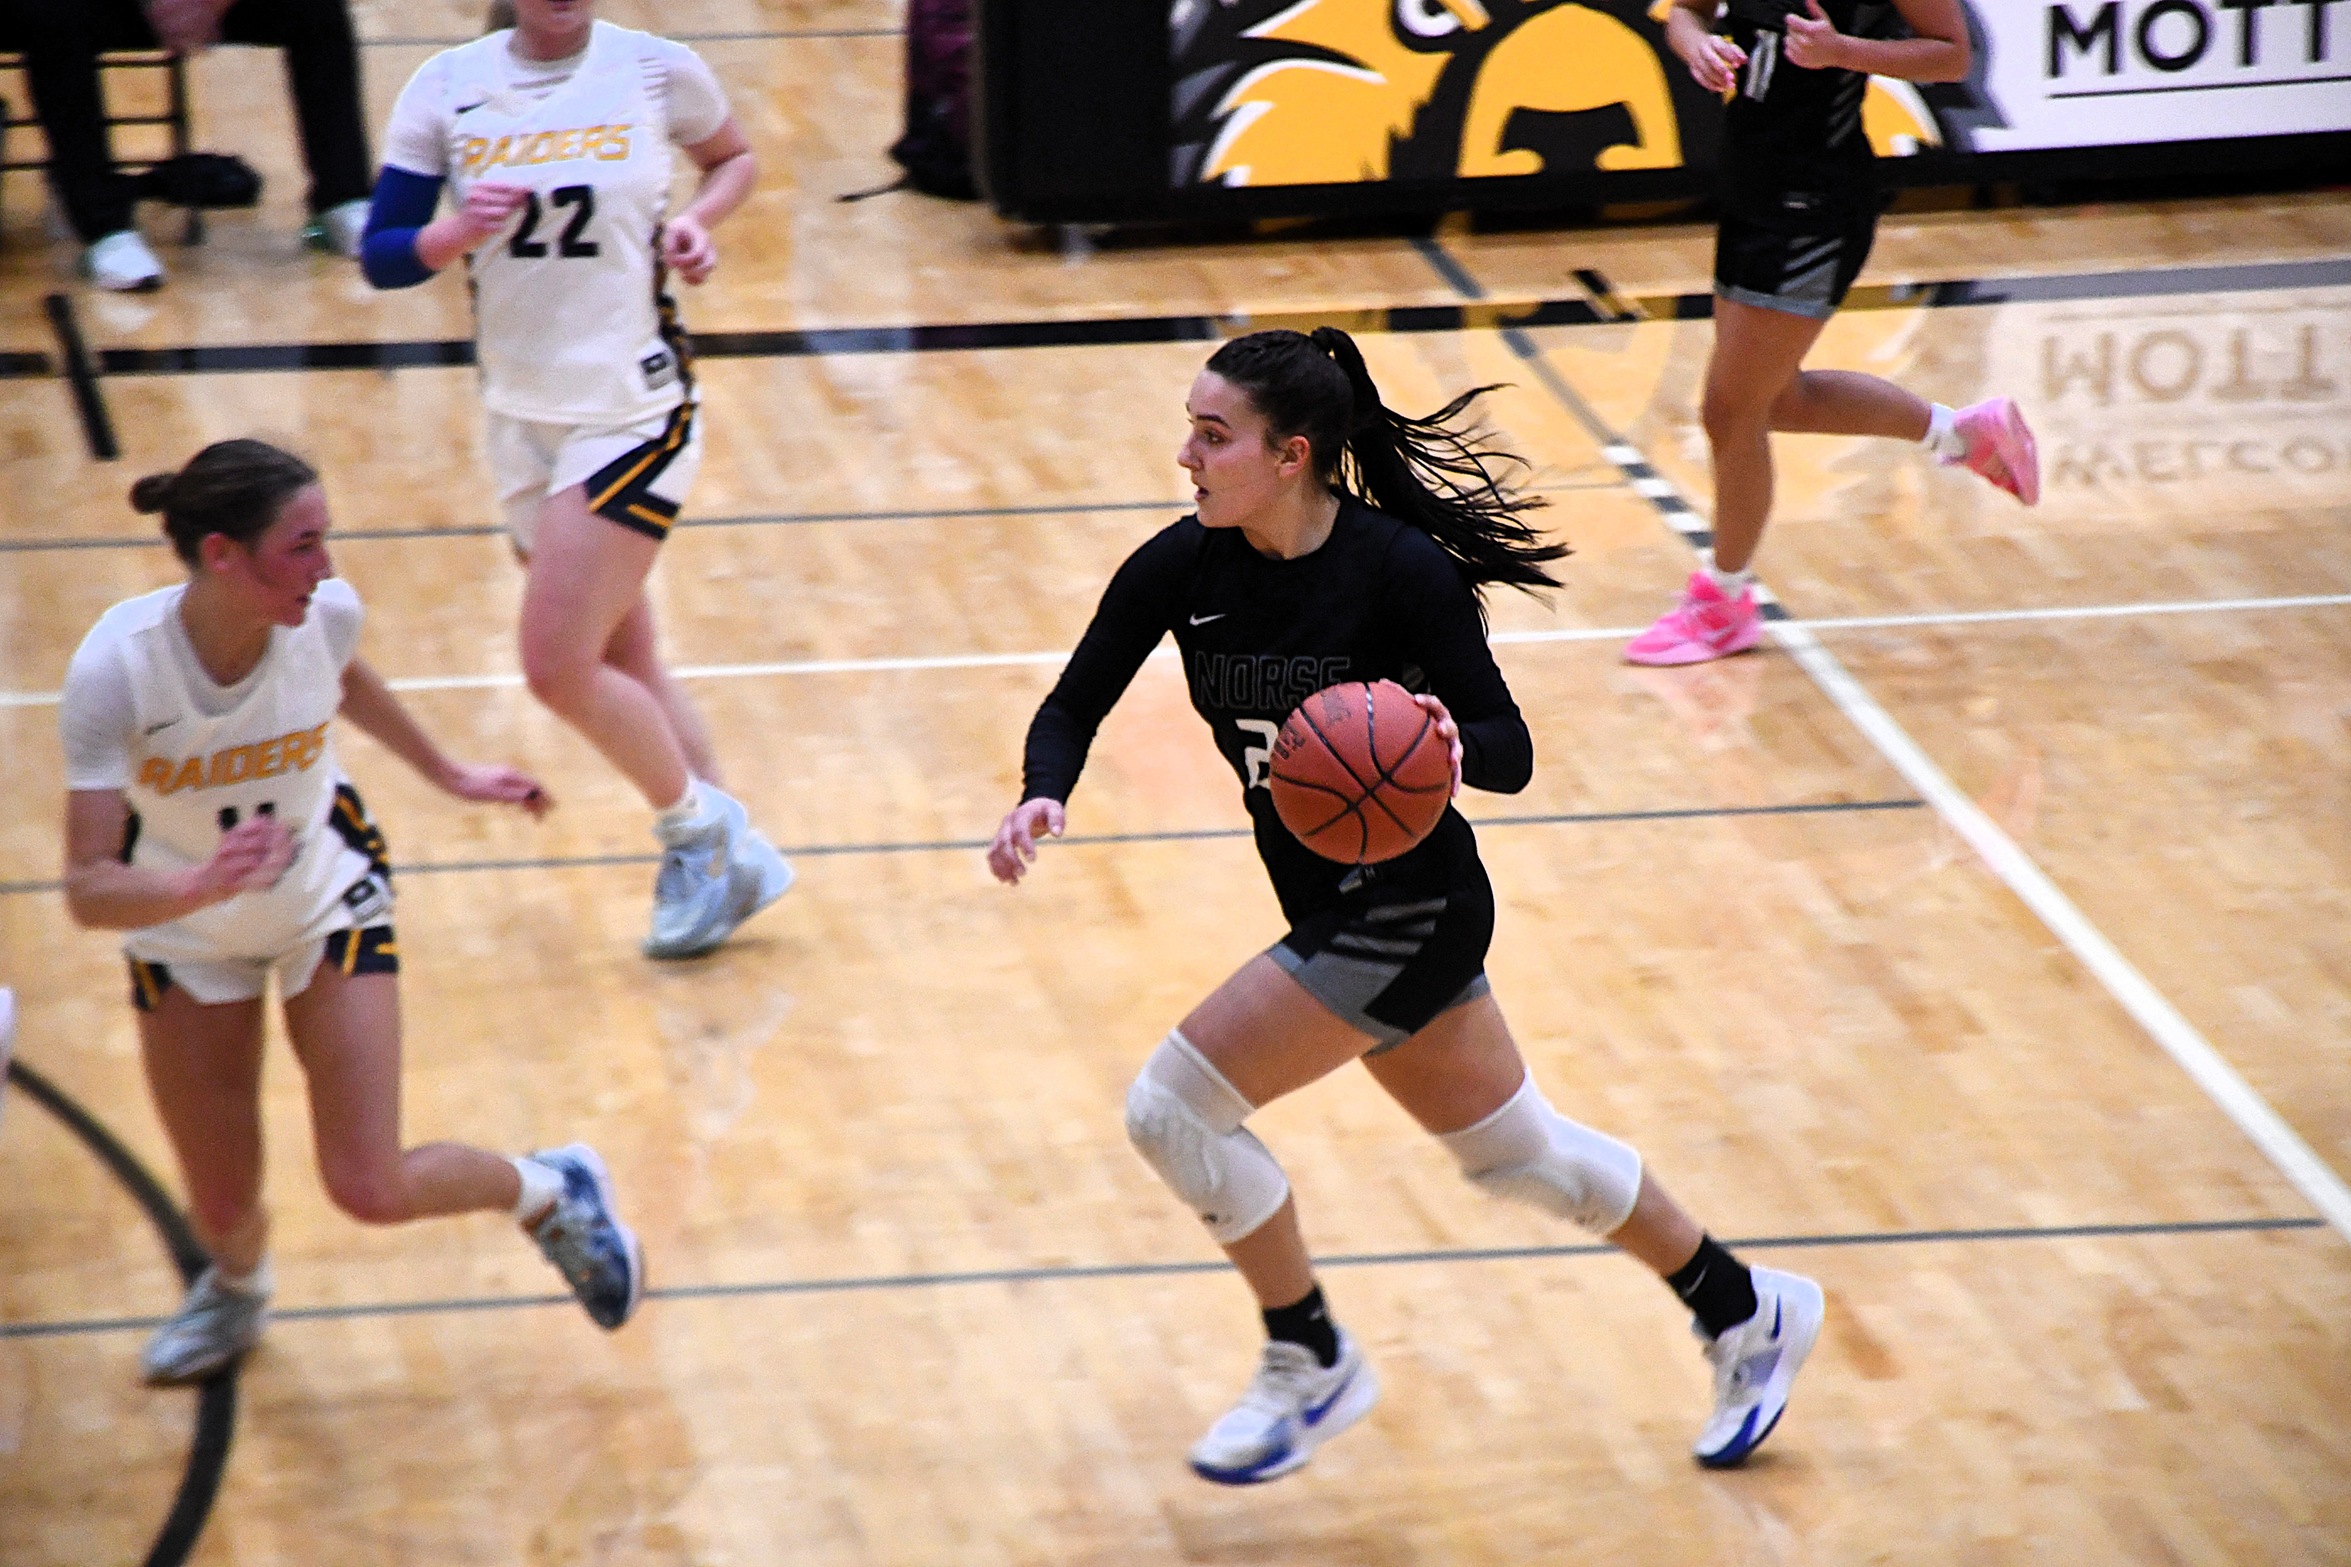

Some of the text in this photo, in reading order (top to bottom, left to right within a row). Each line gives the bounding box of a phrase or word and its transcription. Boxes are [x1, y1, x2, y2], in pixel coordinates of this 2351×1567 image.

[2046, 0, 2345, 78] MOTT
[462, 124, 633, 178] RAIDERS
[508, 184, 600, 258] 22
[138, 721, 329, 796] RAIDERS
